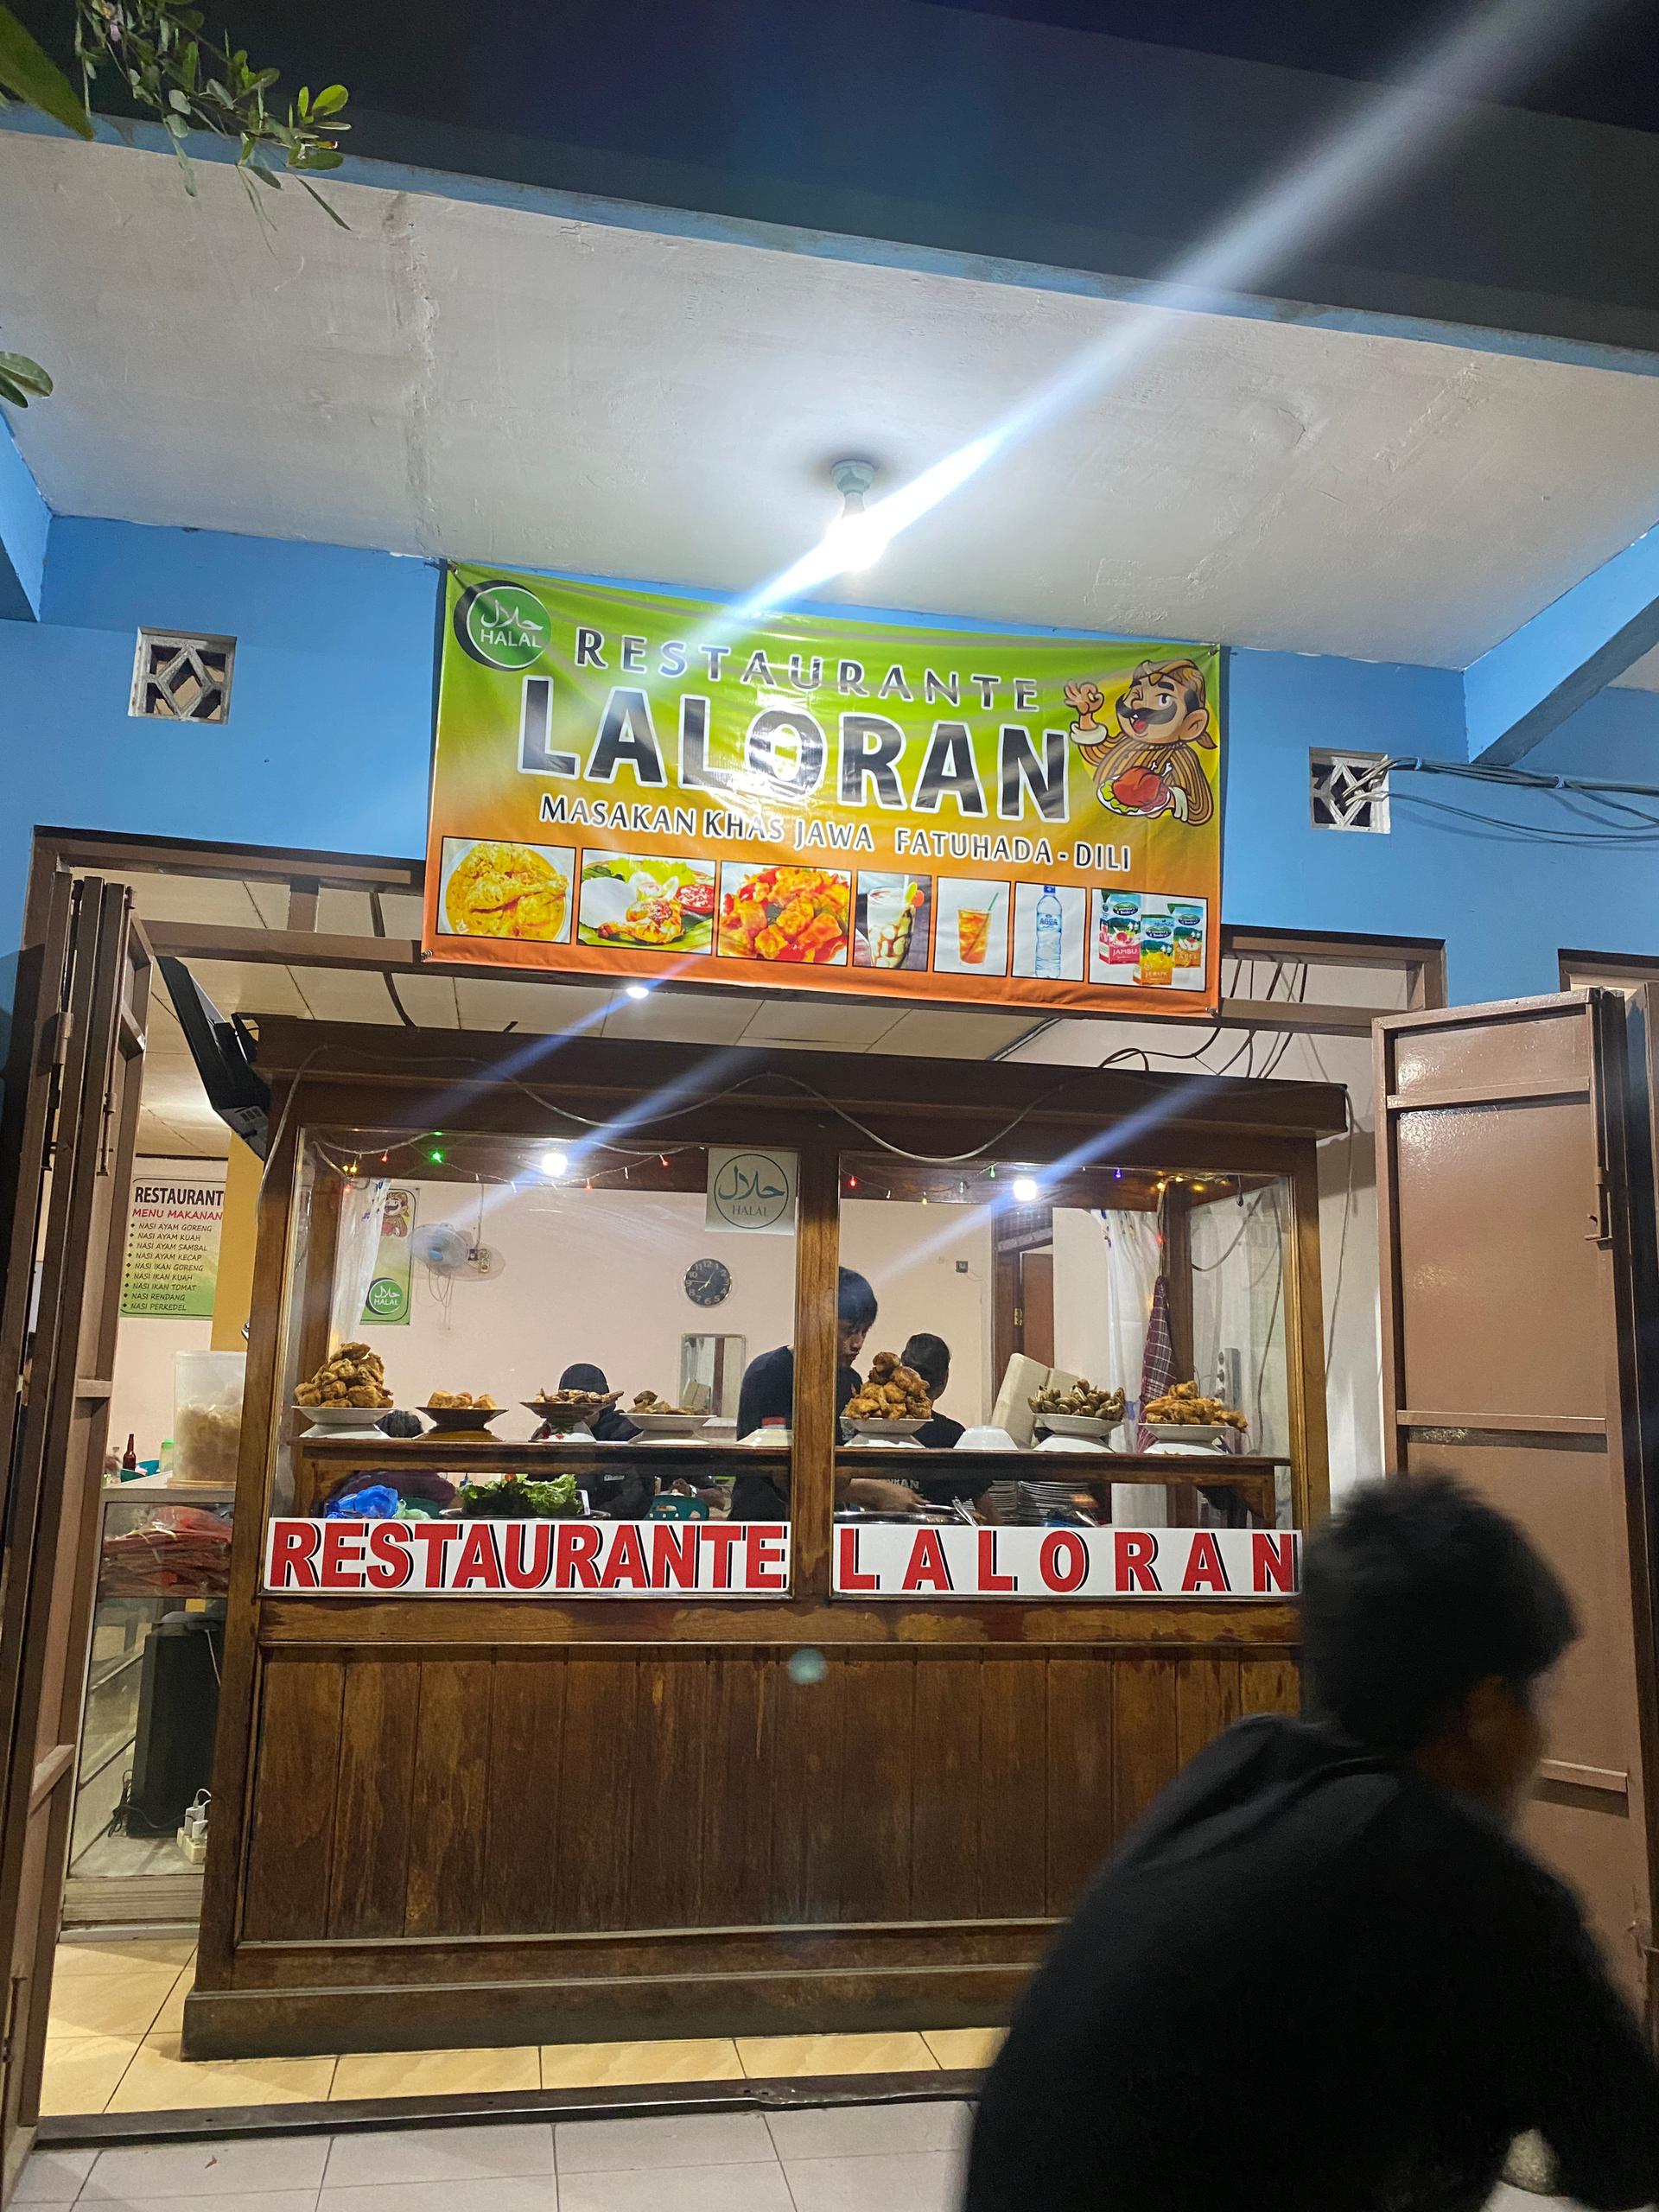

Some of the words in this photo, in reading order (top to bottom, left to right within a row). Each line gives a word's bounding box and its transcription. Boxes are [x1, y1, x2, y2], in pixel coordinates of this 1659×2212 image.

[480, 629, 543, 649] HALAL
[576, 627, 1039, 712] RESTAURANTE
[518, 676, 1070, 823] LALORAN
[539, 792, 695, 836] MASAKAN
[703, 809, 785, 840] KHAS
[793, 819, 875, 852] JAWA
[1113, 948, 1138, 957] JAMBU
[718, 1165, 786, 1200] حلال
[135, 1186, 224, 1206] RESTAURANT
[132, 1208, 164, 1218] MENU
[167, 1210, 224, 1221] MAKANAN
[732, 1205, 769, 1217] HALAL
[178, 1243, 207, 1252] SAMBAL
[150, 1293, 186, 1301] RENDANG
[270, 1522, 787, 1590] RESTAURANTE
[838, 1528, 1298, 1593] LALORAN
